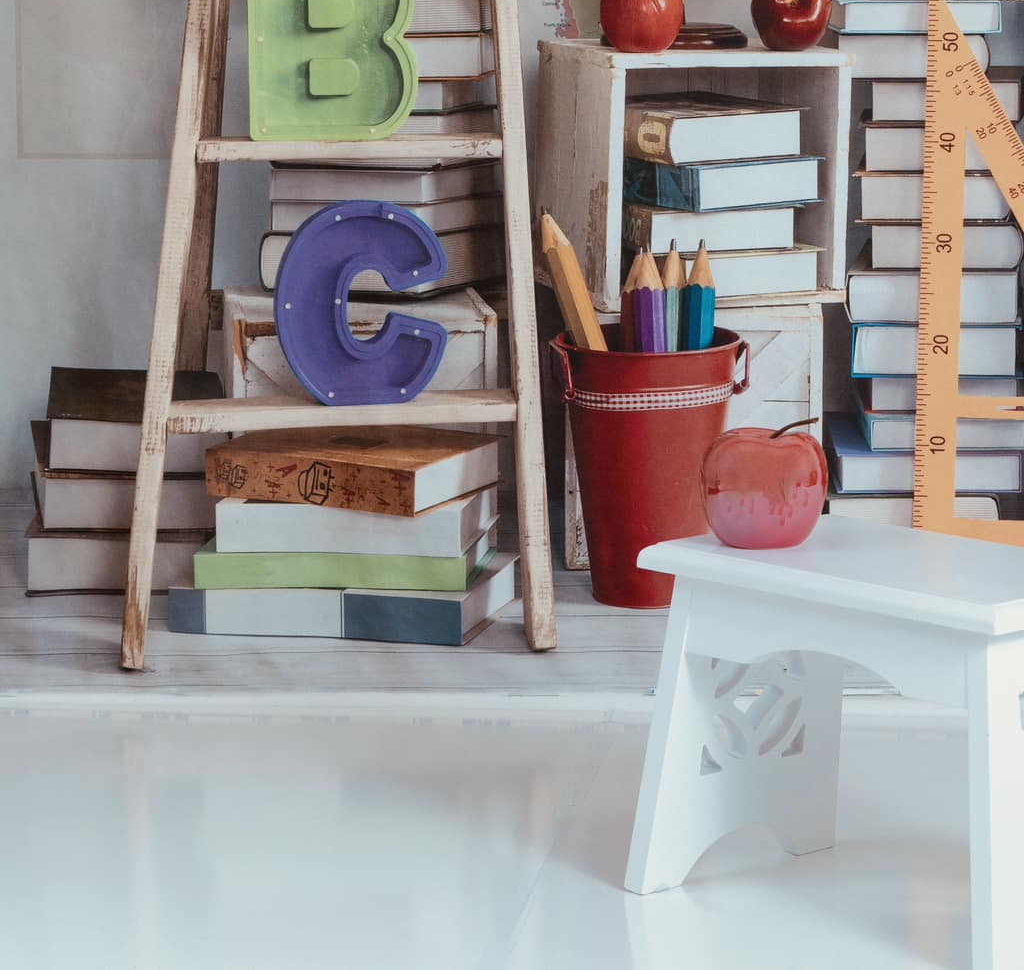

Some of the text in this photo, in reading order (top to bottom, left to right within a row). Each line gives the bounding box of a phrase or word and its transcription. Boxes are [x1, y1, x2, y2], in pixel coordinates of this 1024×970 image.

[943, 32, 959, 52] 50
[976, 128, 987, 139] 20
[987, 123, 997, 134] 10
[939, 132, 956, 153] 40
[1008, 187, 1019, 199] 40
[936, 233, 952, 253] 30
[274, 200, 448, 406] C
[933, 334, 949, 354] 20
[930, 436, 945, 455] 10
